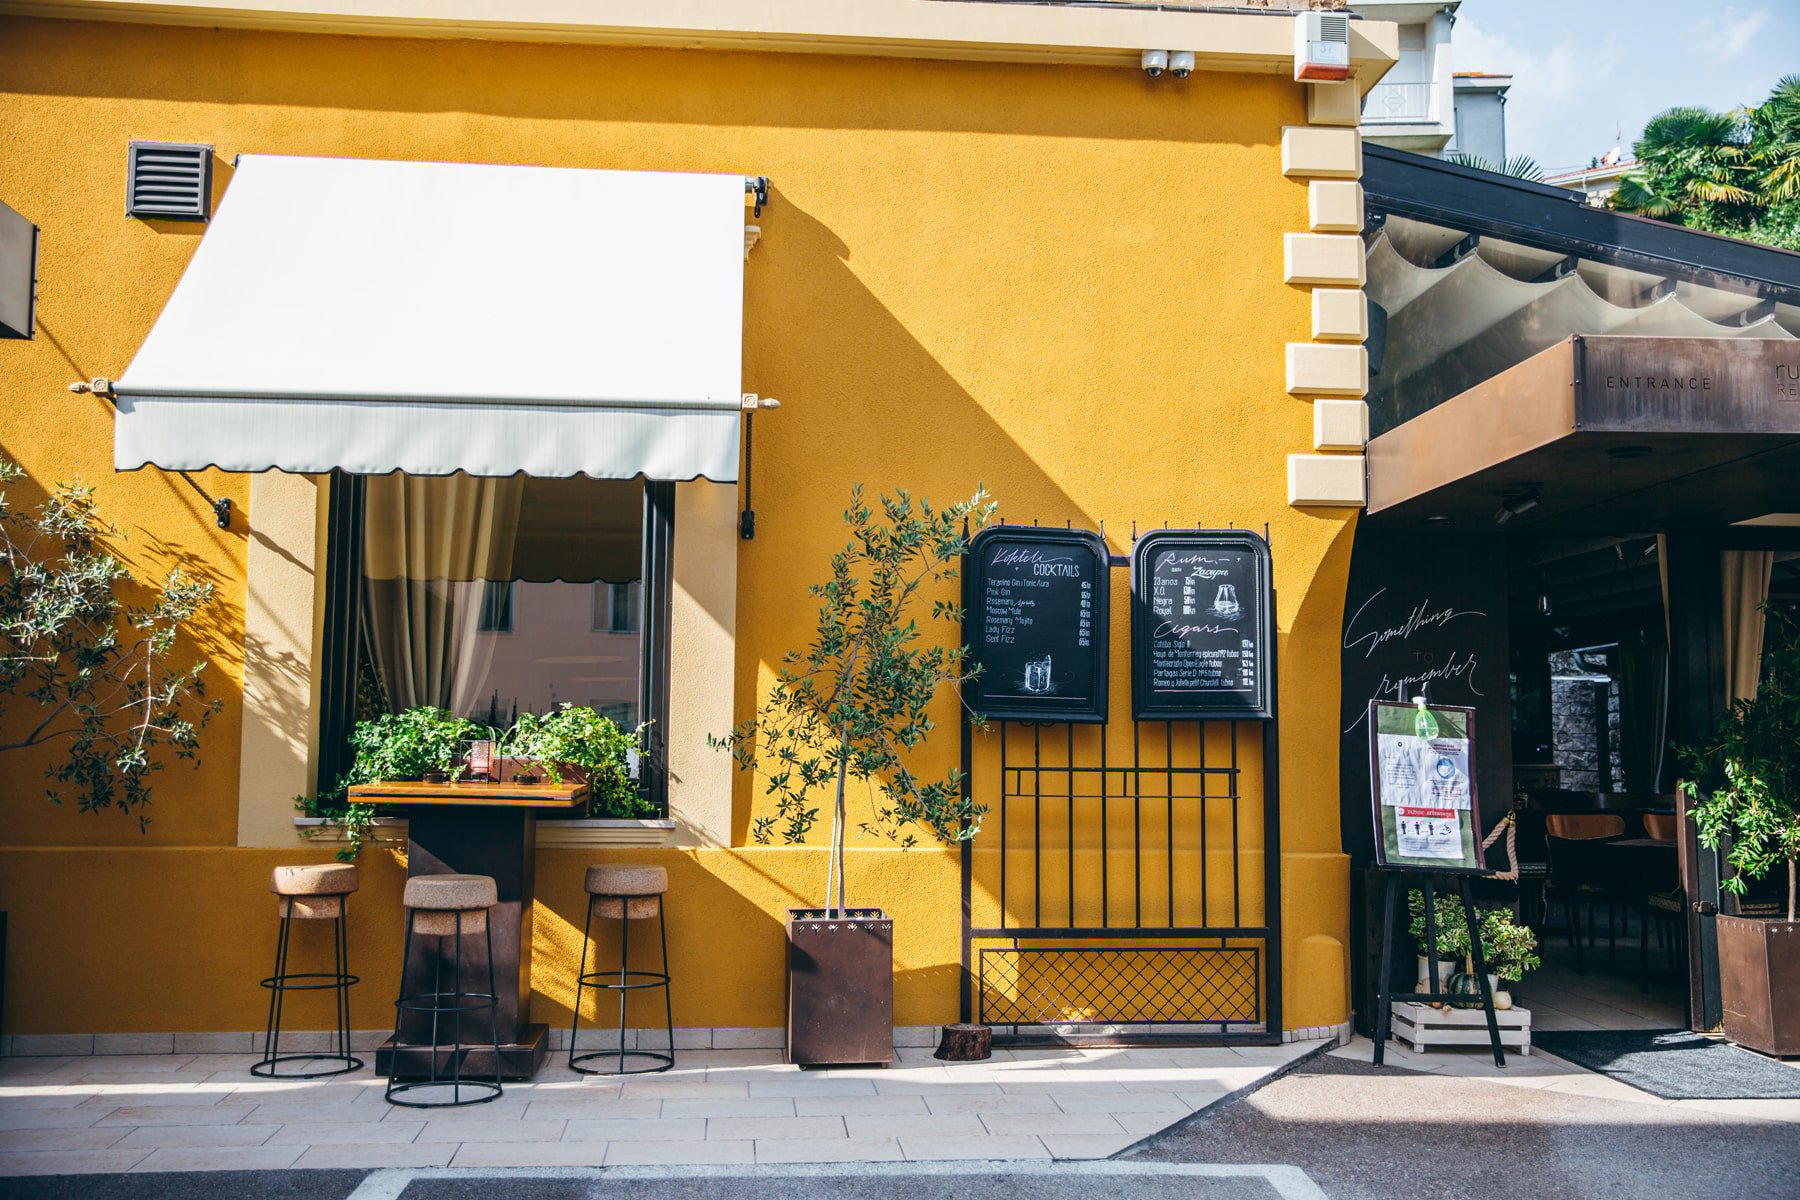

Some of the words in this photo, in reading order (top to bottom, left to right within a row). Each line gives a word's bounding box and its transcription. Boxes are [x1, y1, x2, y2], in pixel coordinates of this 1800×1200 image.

[1776, 364, 1800, 380] ru
[1606, 376, 1712, 391] ENTRANCE
[1033, 564, 1080, 578] COCKTAILS
[1191, 566, 1229, 580] Zacapa
[986, 588, 999, 596] Pink
[1000, 588, 1011, 597] Gin
[1153, 596, 1173, 606] Negra
[986, 606, 1008, 615] Moscow
[1008, 606, 1022, 616] Mule
[1153, 605, 1172, 617] Royal
[986, 616, 1013, 626] Rosemary
[1344, 587, 1486, 658] Something
[985, 624, 999, 634] Lady
[1001, 625, 1015, 634] Fizz
[1153, 620, 1238, 639] Cigars
[985, 634, 999, 643] Gent
[1001, 634, 1015, 644] Fizz
